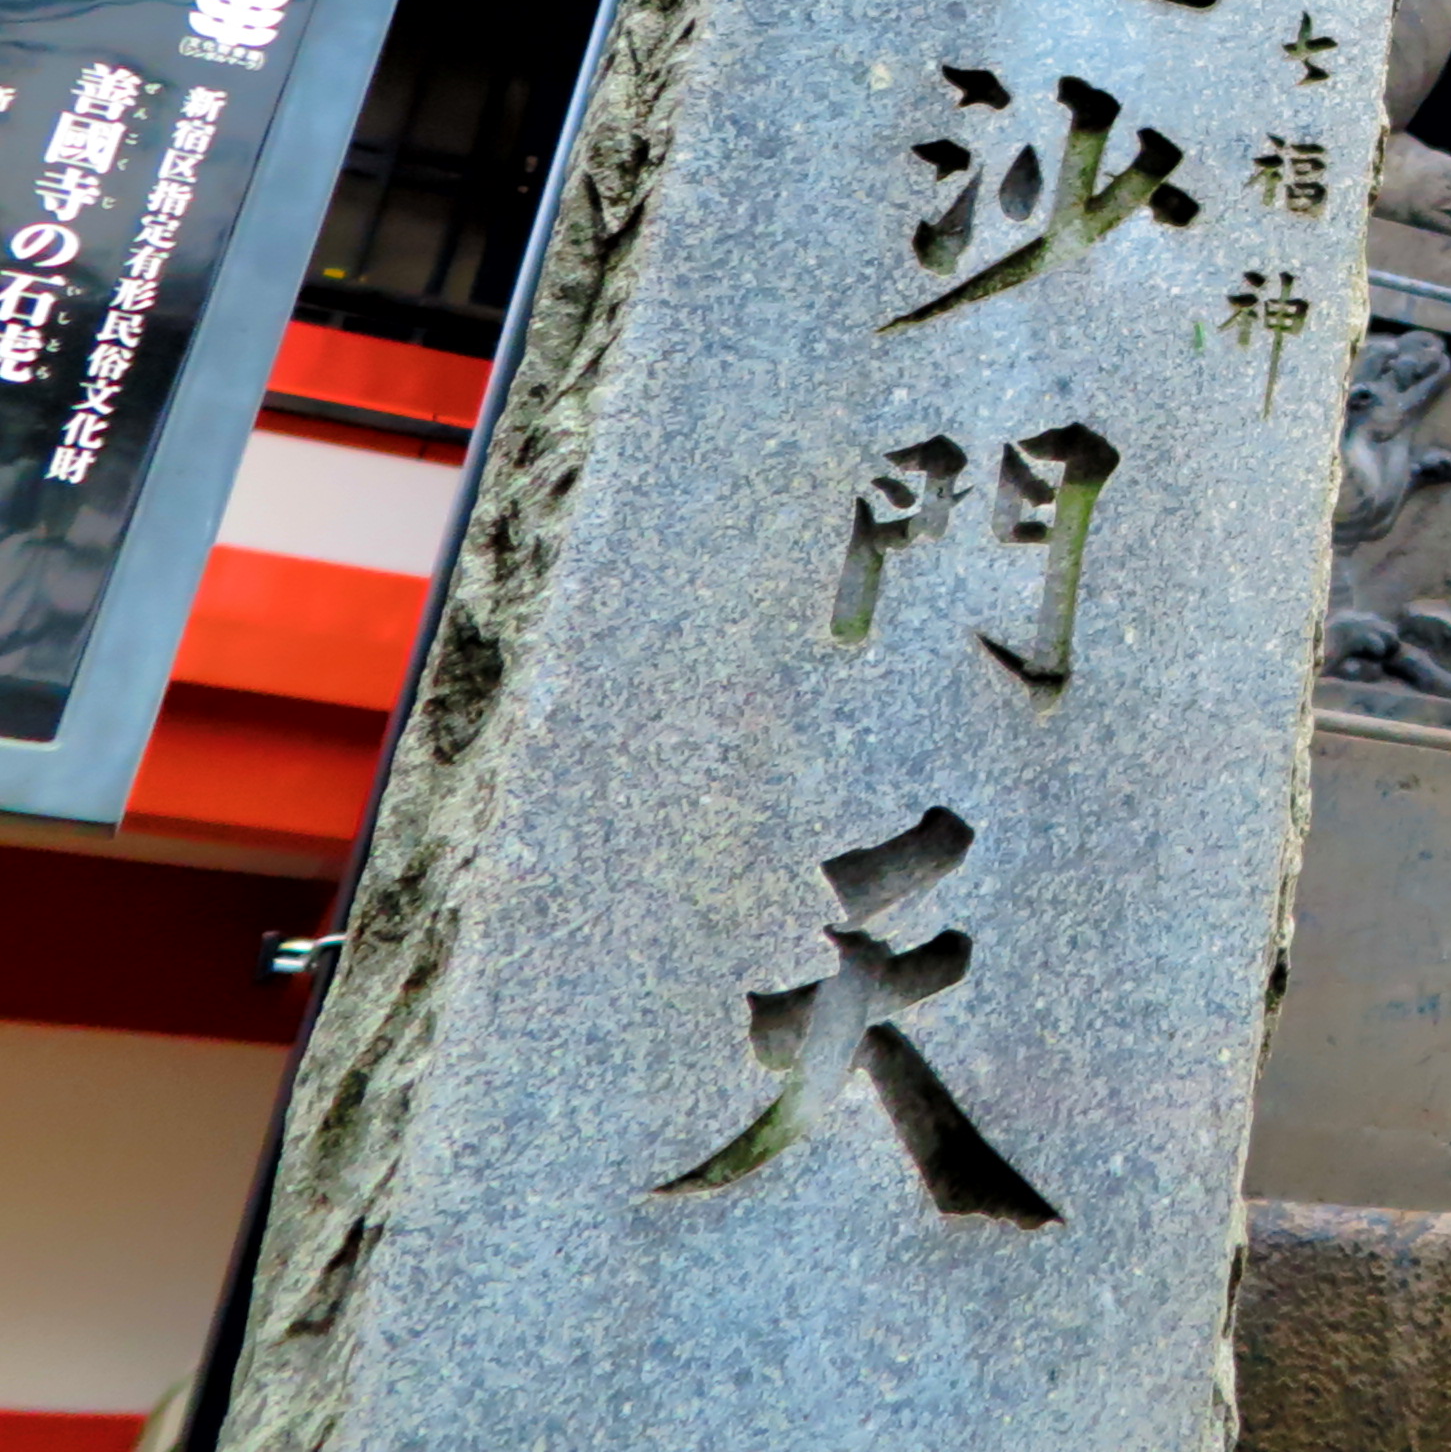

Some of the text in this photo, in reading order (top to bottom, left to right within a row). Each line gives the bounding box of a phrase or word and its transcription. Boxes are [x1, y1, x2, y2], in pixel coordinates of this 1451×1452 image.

[43, 85, 228, 485] 新宿区指定有形民俗文化財
